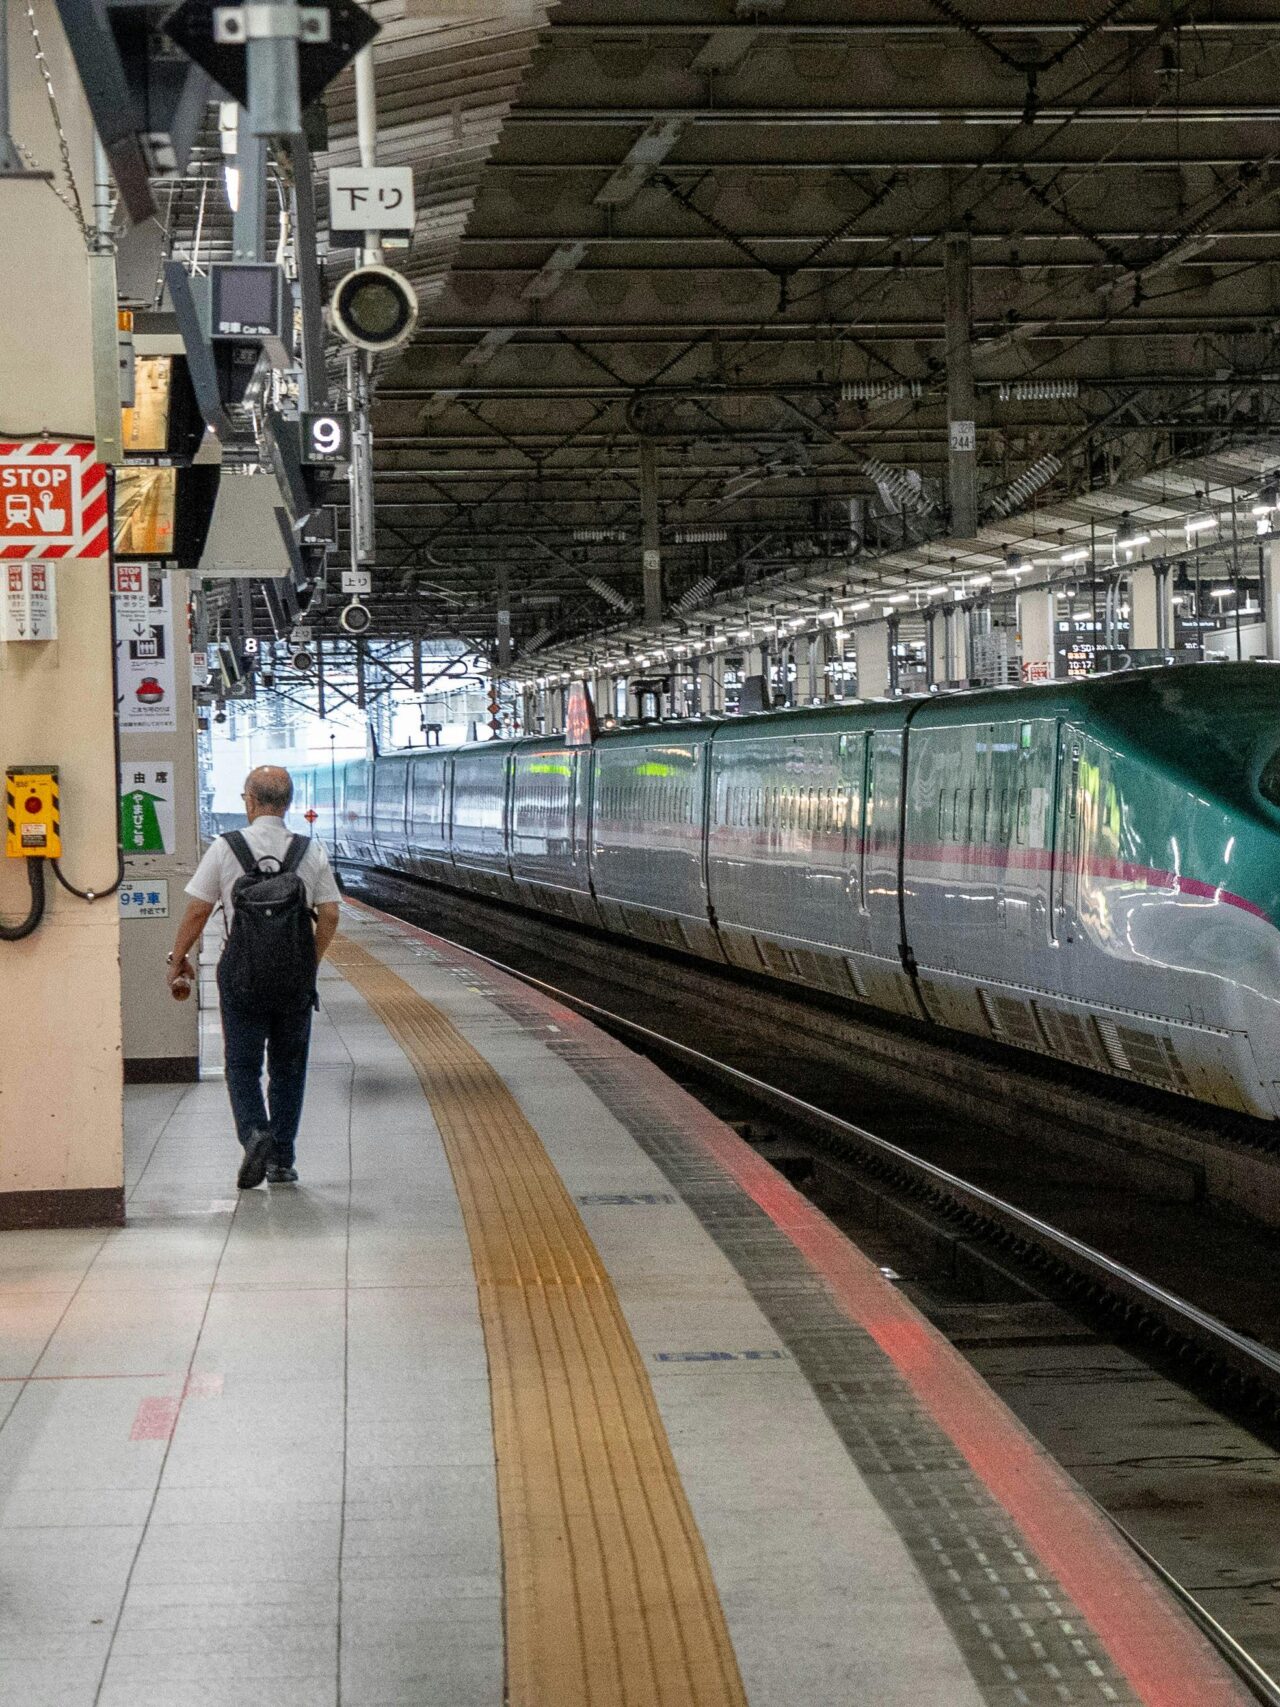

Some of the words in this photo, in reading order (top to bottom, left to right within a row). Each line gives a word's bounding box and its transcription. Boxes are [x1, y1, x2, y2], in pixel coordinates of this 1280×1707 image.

[337, 187, 402, 211] 下り
[313, 418, 340, 453] 9
[2, 468, 67, 487] STOP
[345, 578, 368, 587] 上り
[245, 638, 257, 652] 8
[134, 771, 168, 784] 由席
[132, 793, 144, 847] やまびこ号
[120, 891, 161, 905] 9号車
